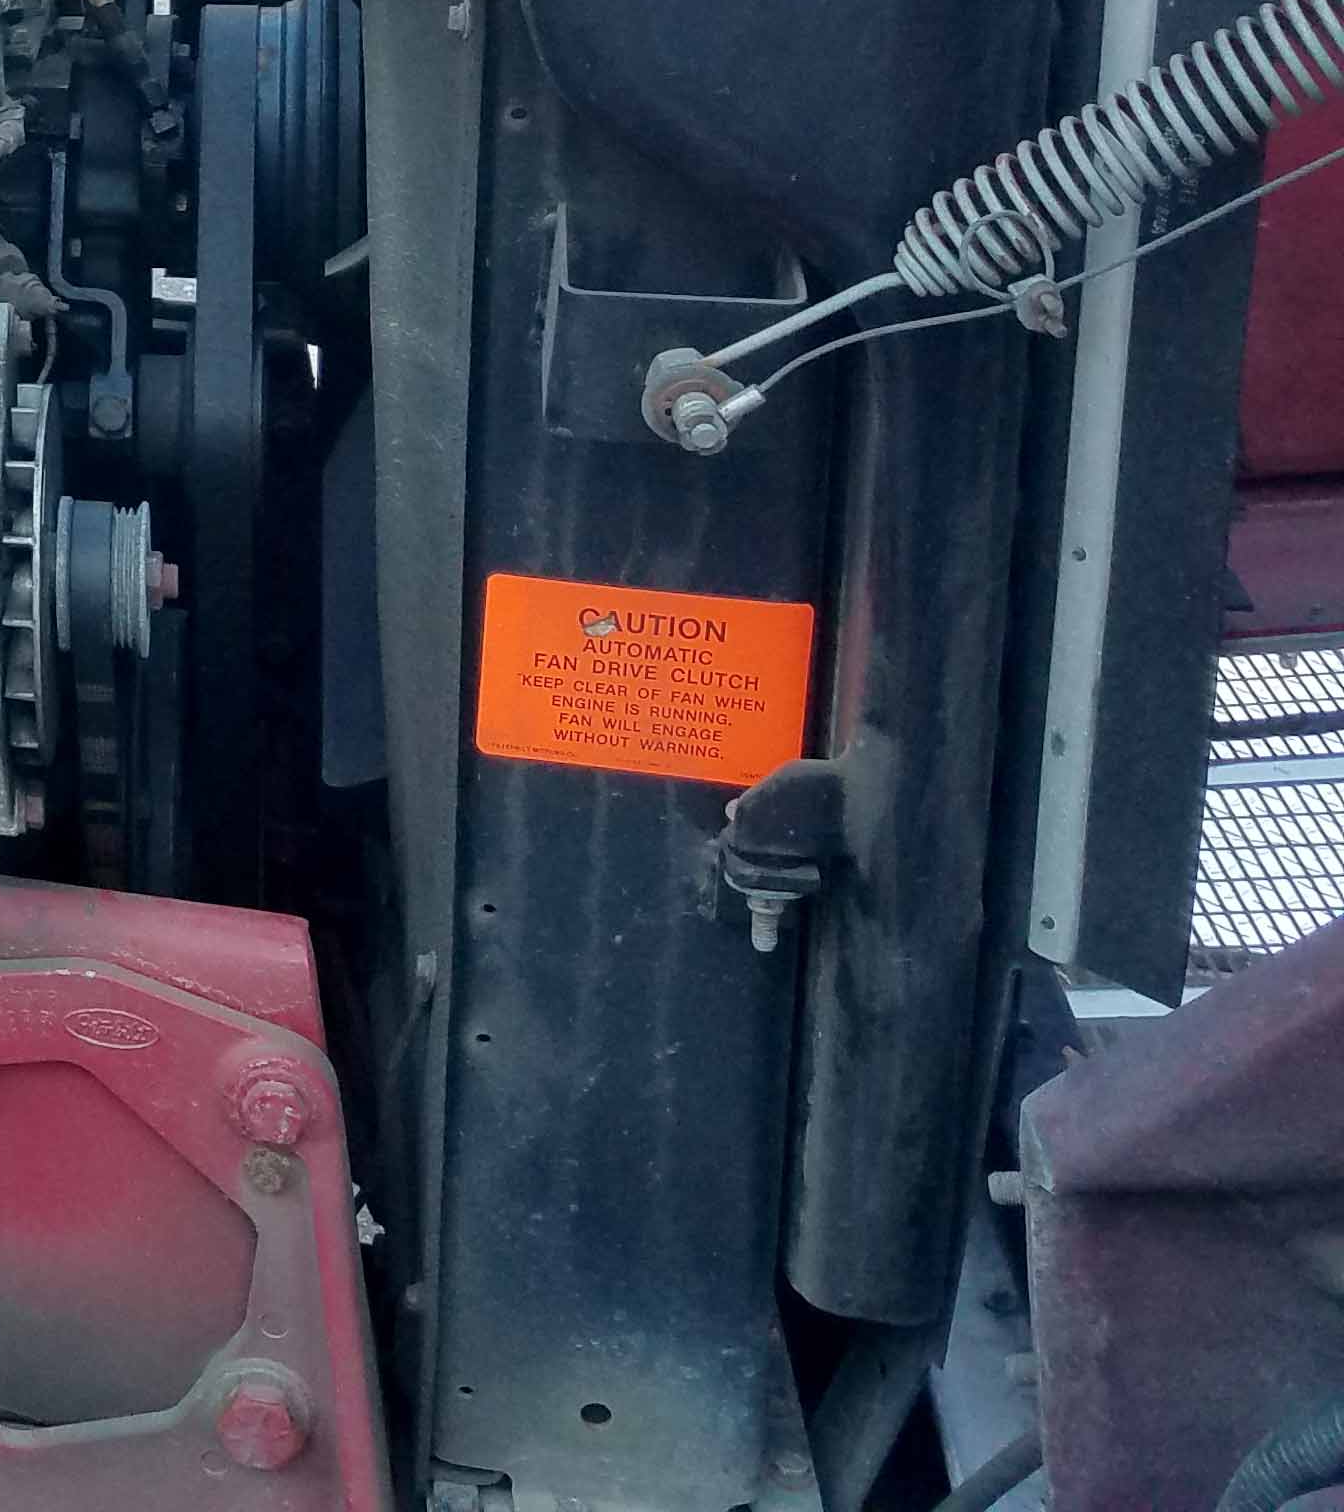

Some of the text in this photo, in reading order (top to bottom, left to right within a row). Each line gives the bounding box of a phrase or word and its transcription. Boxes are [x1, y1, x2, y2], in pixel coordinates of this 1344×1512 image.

[578, 608, 728, 643] CAUTION
[583, 639, 713, 666] AUTOMATIC
[534, 653, 760, 692] FAN DRIVE CLUTCH
[552, 695, 732, 727] ENGINE IS RUNNING.
[573, 680, 628, 697] CLEAR
[638, 687, 662, 700] OF
[671, 691, 705, 706] FAN
[715, 695, 766, 713] WHEN
[559, 712, 723, 742] FAN WILL ENGAGE
[553, 728, 724, 760] WITHOUT WARNING.
